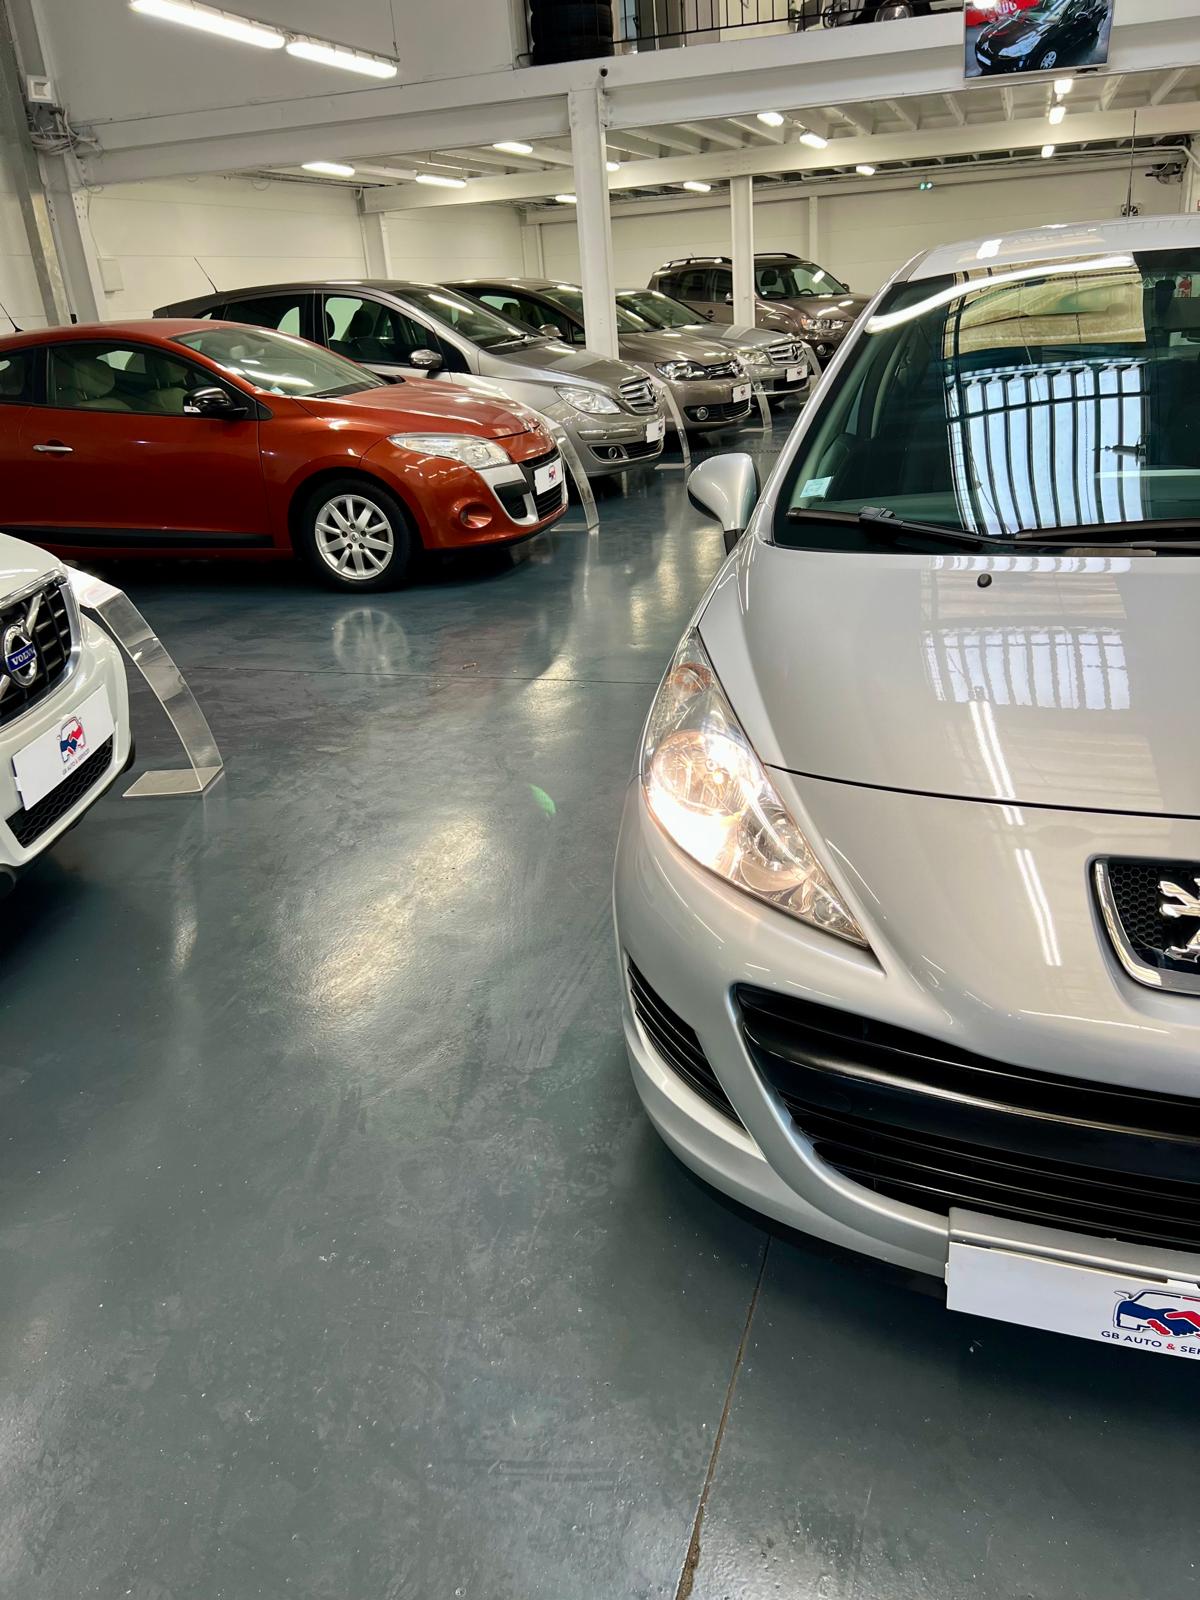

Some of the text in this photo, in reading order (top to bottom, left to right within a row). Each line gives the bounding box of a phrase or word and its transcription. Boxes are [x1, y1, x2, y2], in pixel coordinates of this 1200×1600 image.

[1101, 1330, 1120, 1340] GB
[1123, 1335, 1162, 1348] AUTO
[1166, 1343, 1176, 1351] &
